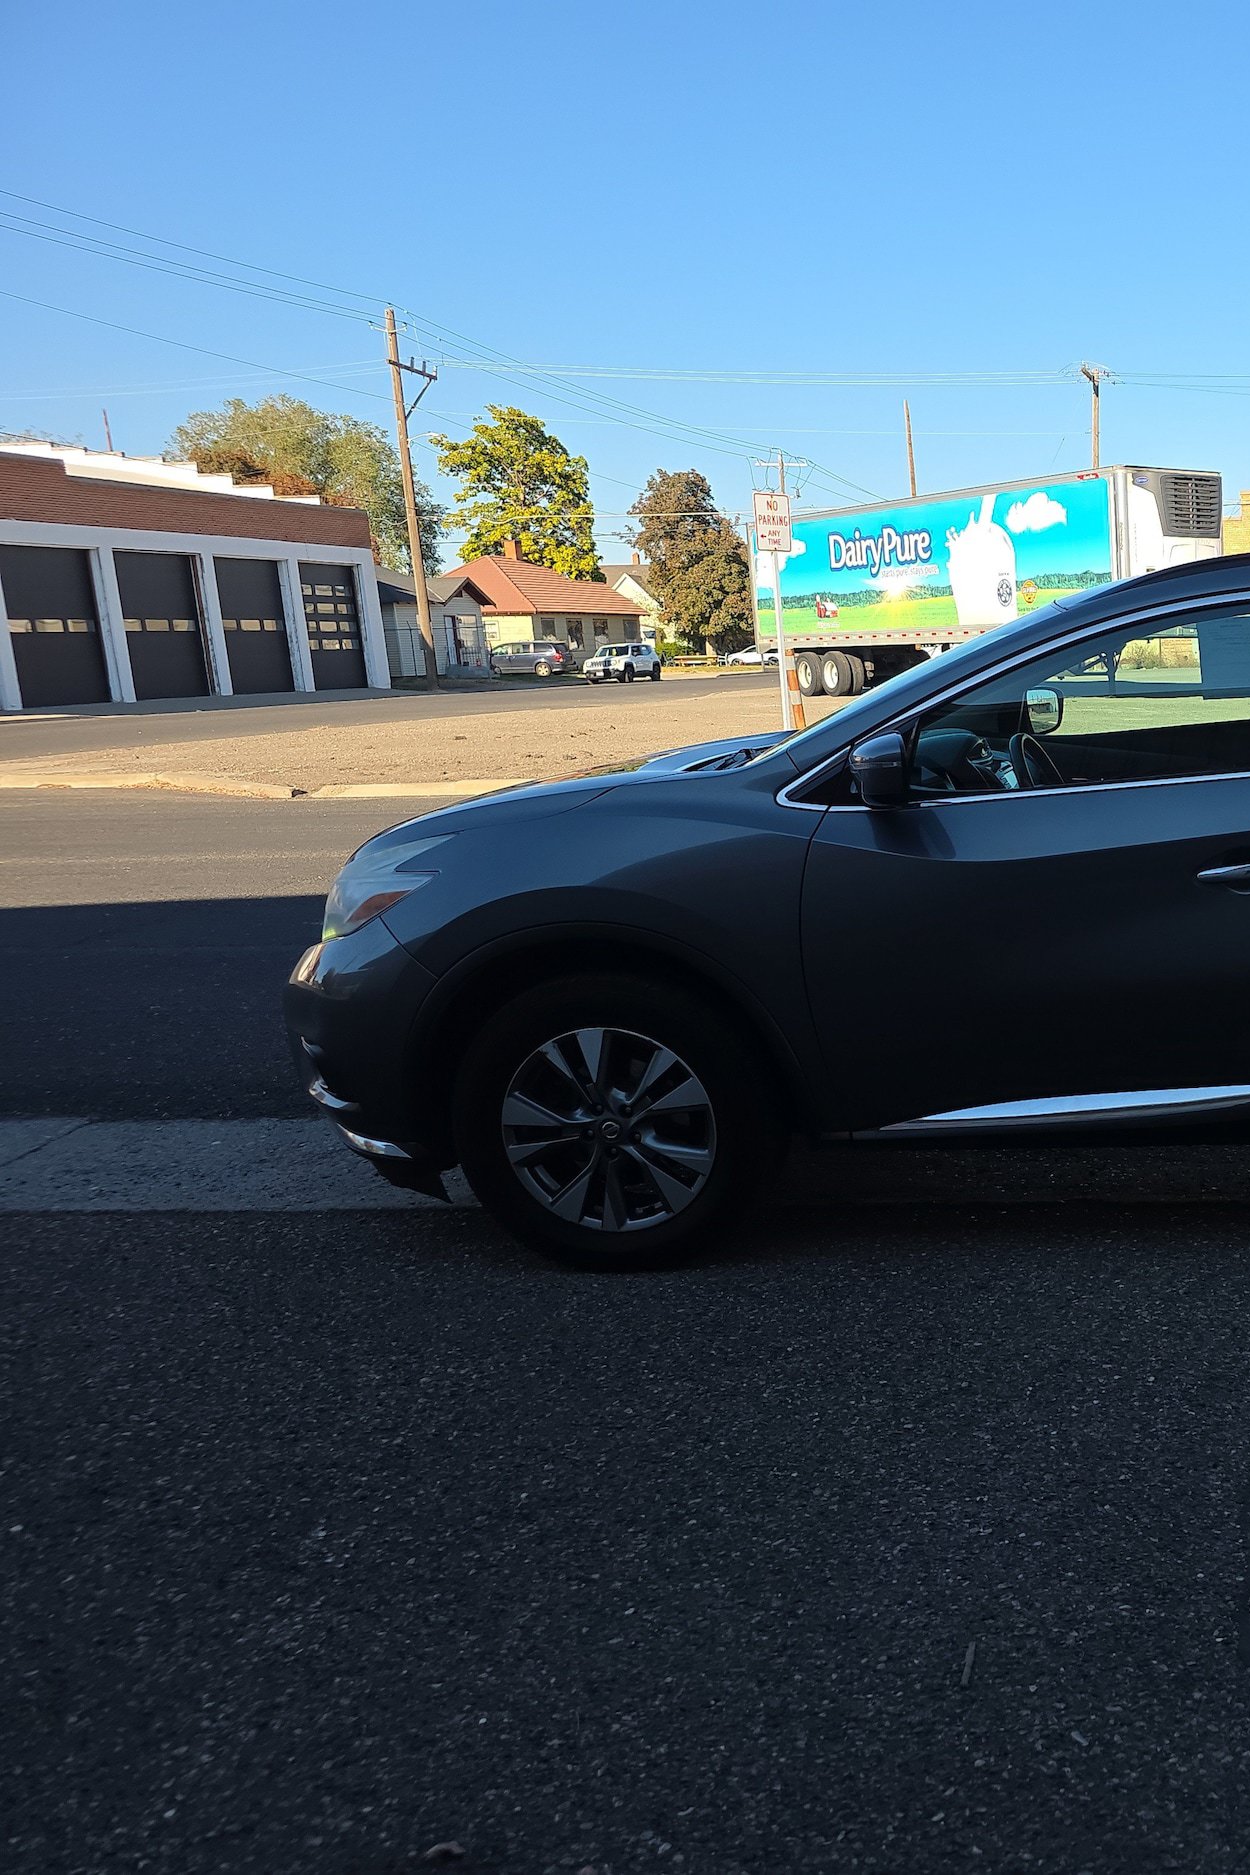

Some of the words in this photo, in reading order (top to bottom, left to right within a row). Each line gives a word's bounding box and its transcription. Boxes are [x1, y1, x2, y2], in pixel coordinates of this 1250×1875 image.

[766, 500, 778, 511] NO
[758, 514, 788, 526] PARKING
[828, 525, 932, 577] DairyPure
